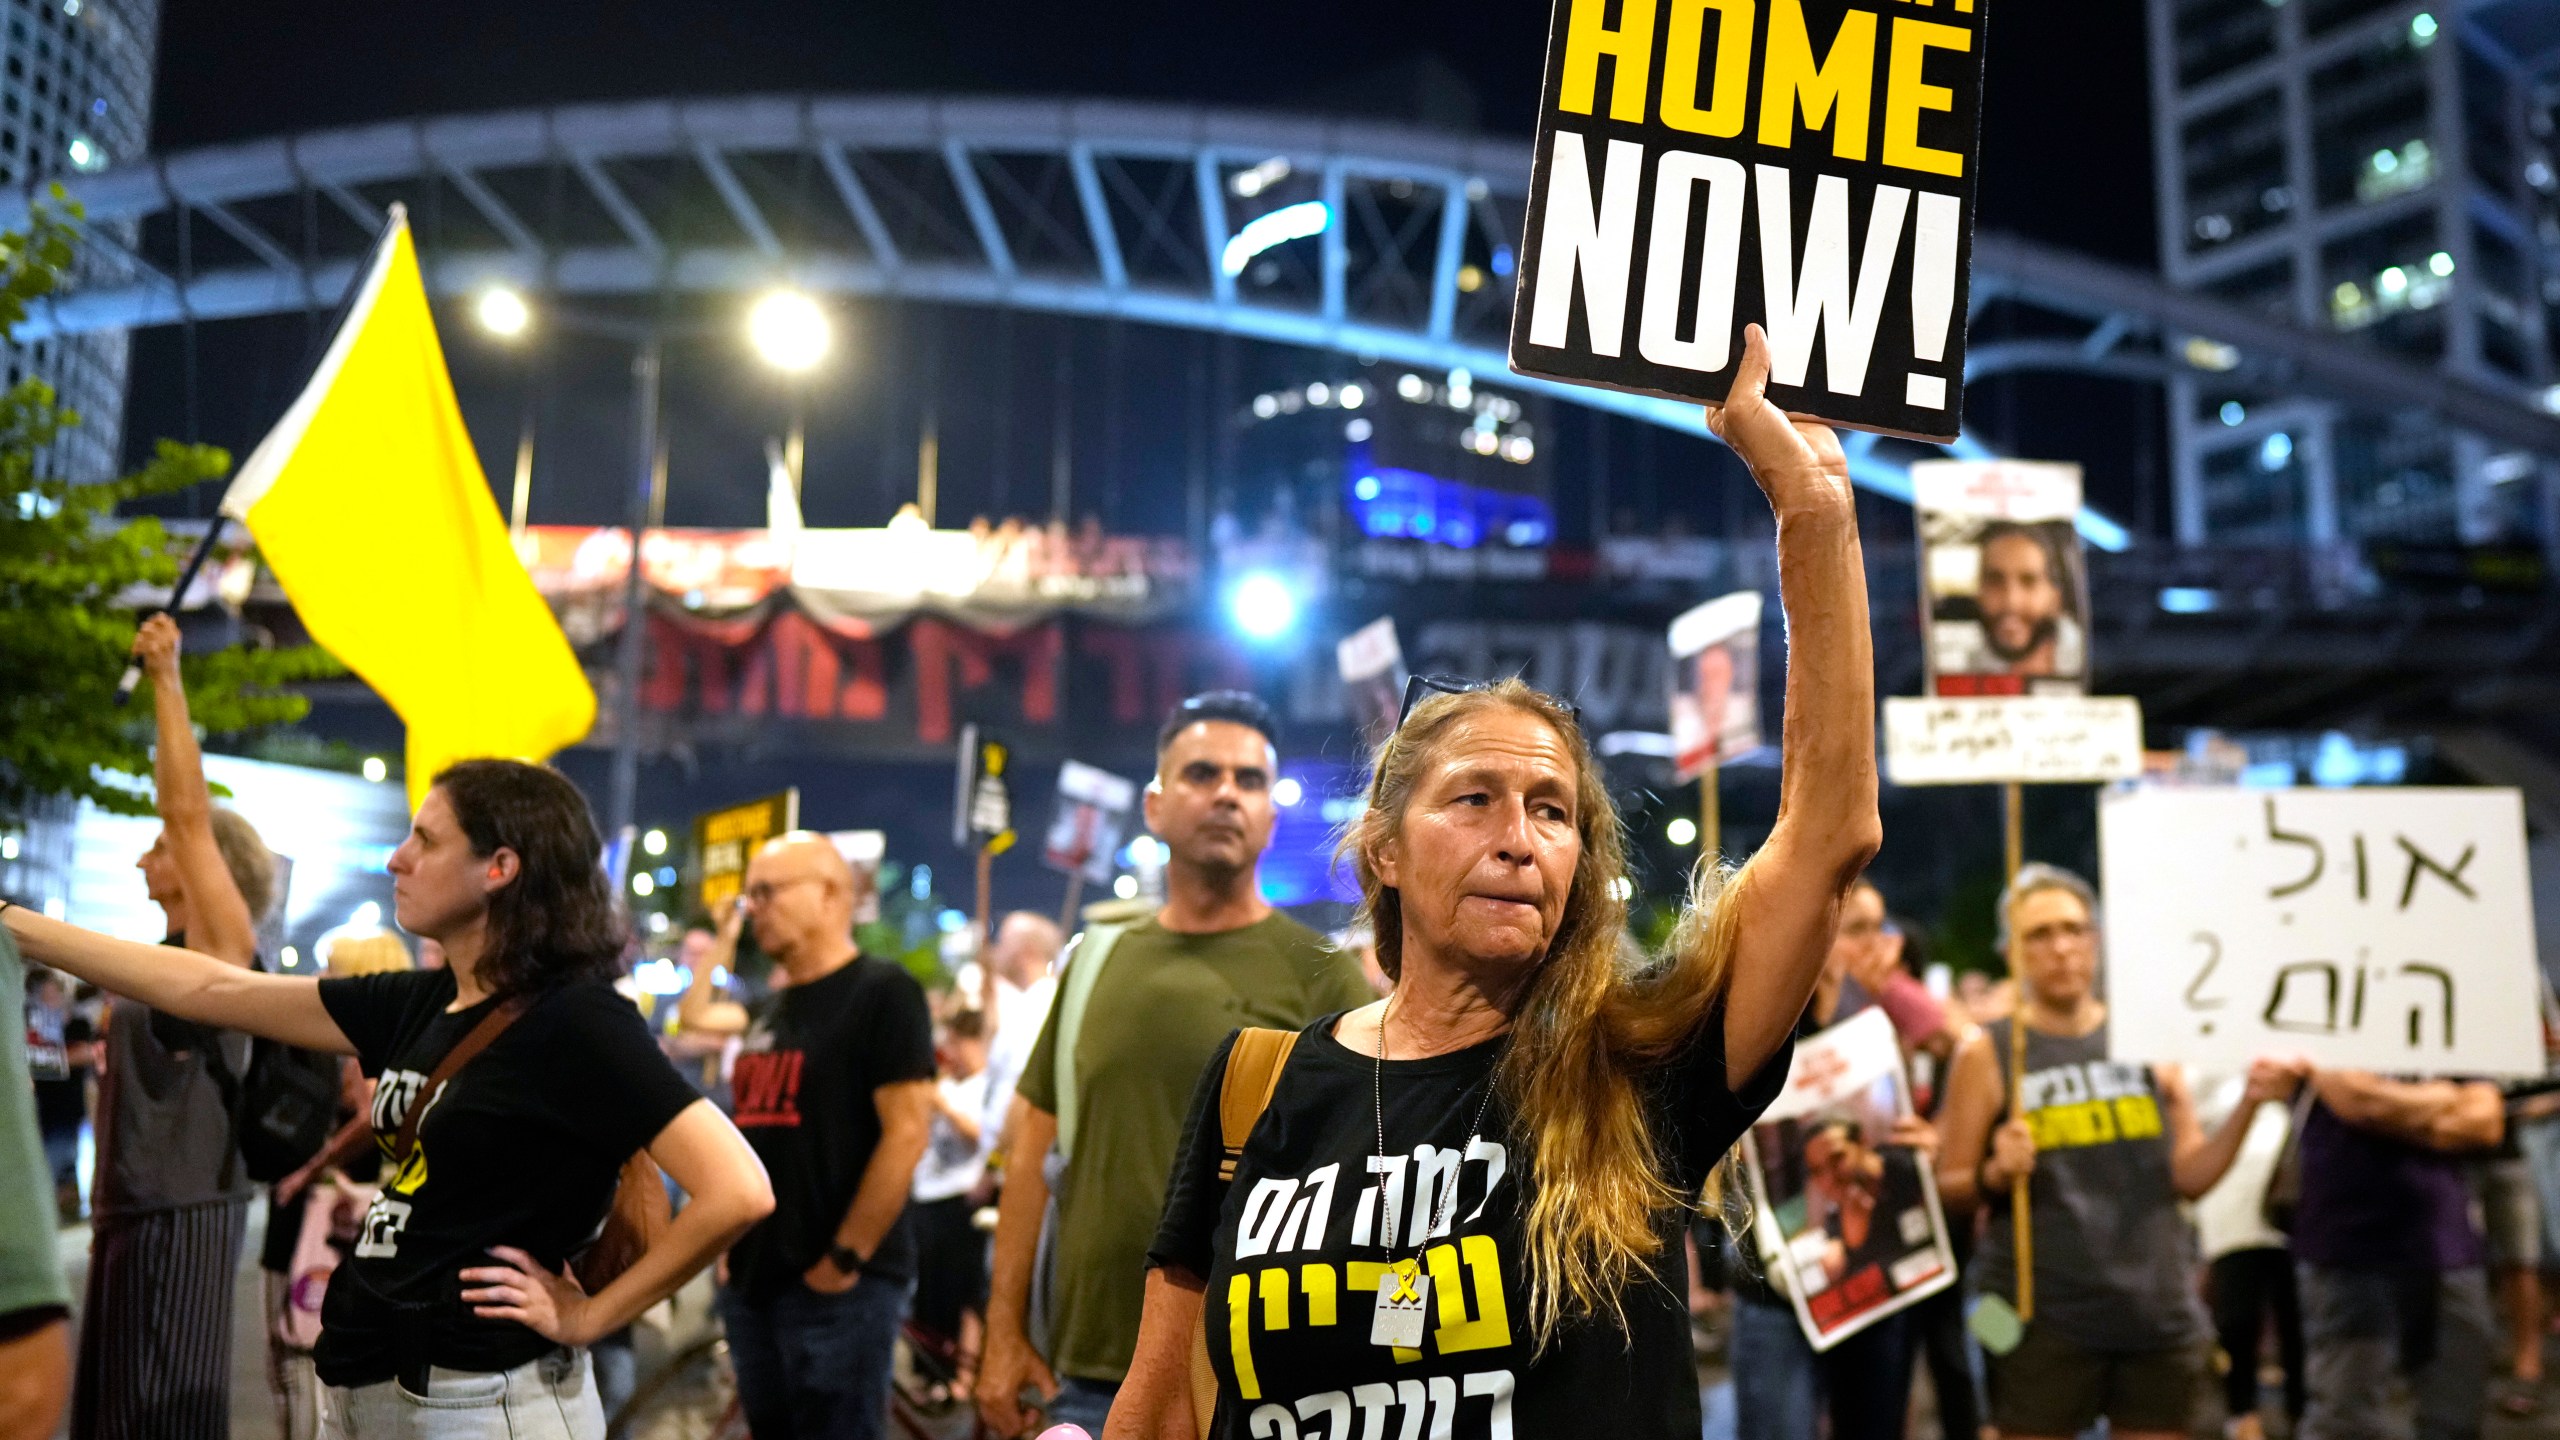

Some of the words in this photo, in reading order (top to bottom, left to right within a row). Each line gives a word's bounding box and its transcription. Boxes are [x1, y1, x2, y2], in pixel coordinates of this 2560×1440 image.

[1559, 0, 1971, 178] HOME
[1529, 130, 1961, 411] NOW!
[1236, 1162, 1340, 1260] הם
[1351, 1134, 1507, 1248] למה
[1228, 1235, 1511, 1399] עדיין
